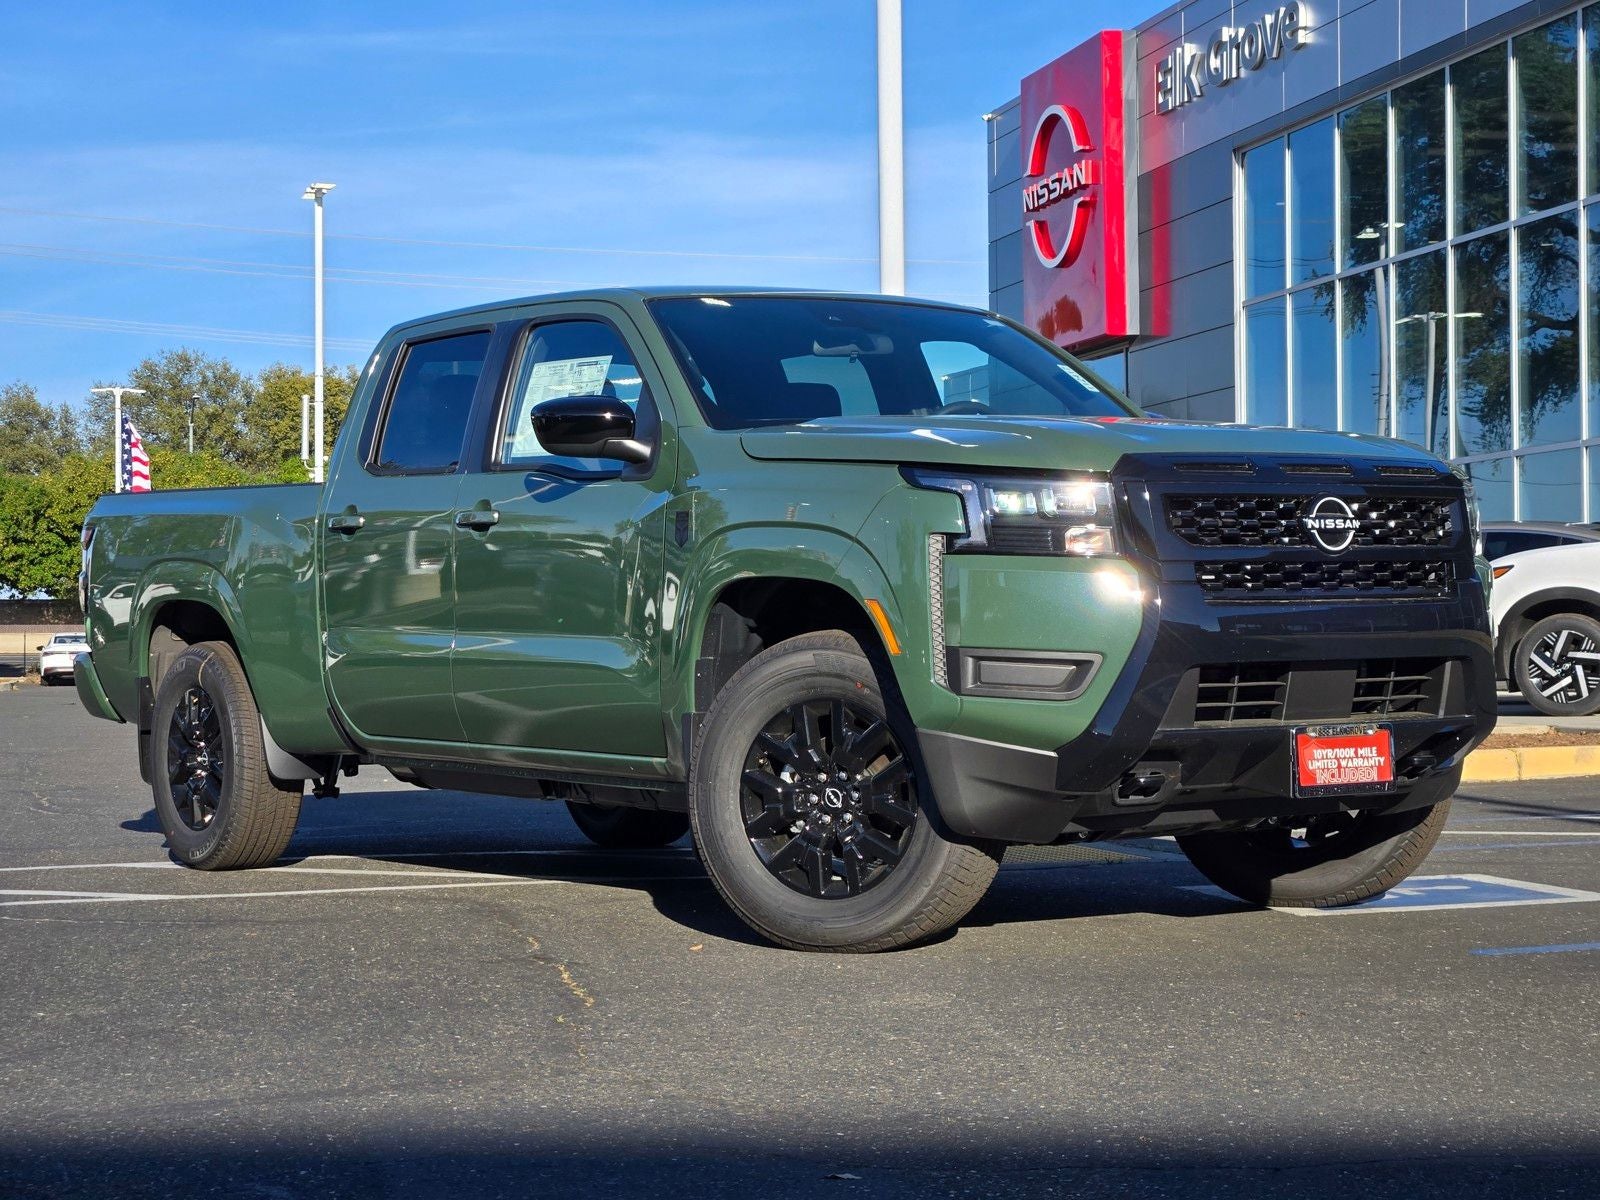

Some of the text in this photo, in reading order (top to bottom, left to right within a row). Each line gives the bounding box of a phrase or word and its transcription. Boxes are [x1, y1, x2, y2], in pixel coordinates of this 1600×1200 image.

[1155, 1, 1308, 115] Elk Grove
[1023, 160, 1089, 212] NISSAN
[1307, 518, 1360, 529] NISSAN
[1313, 747, 1377, 759] 10YR/100K MILE
[1308, 757, 1385, 769] LIMITED WARRANTY
[1316, 767, 1378, 783] INCLUDED!
